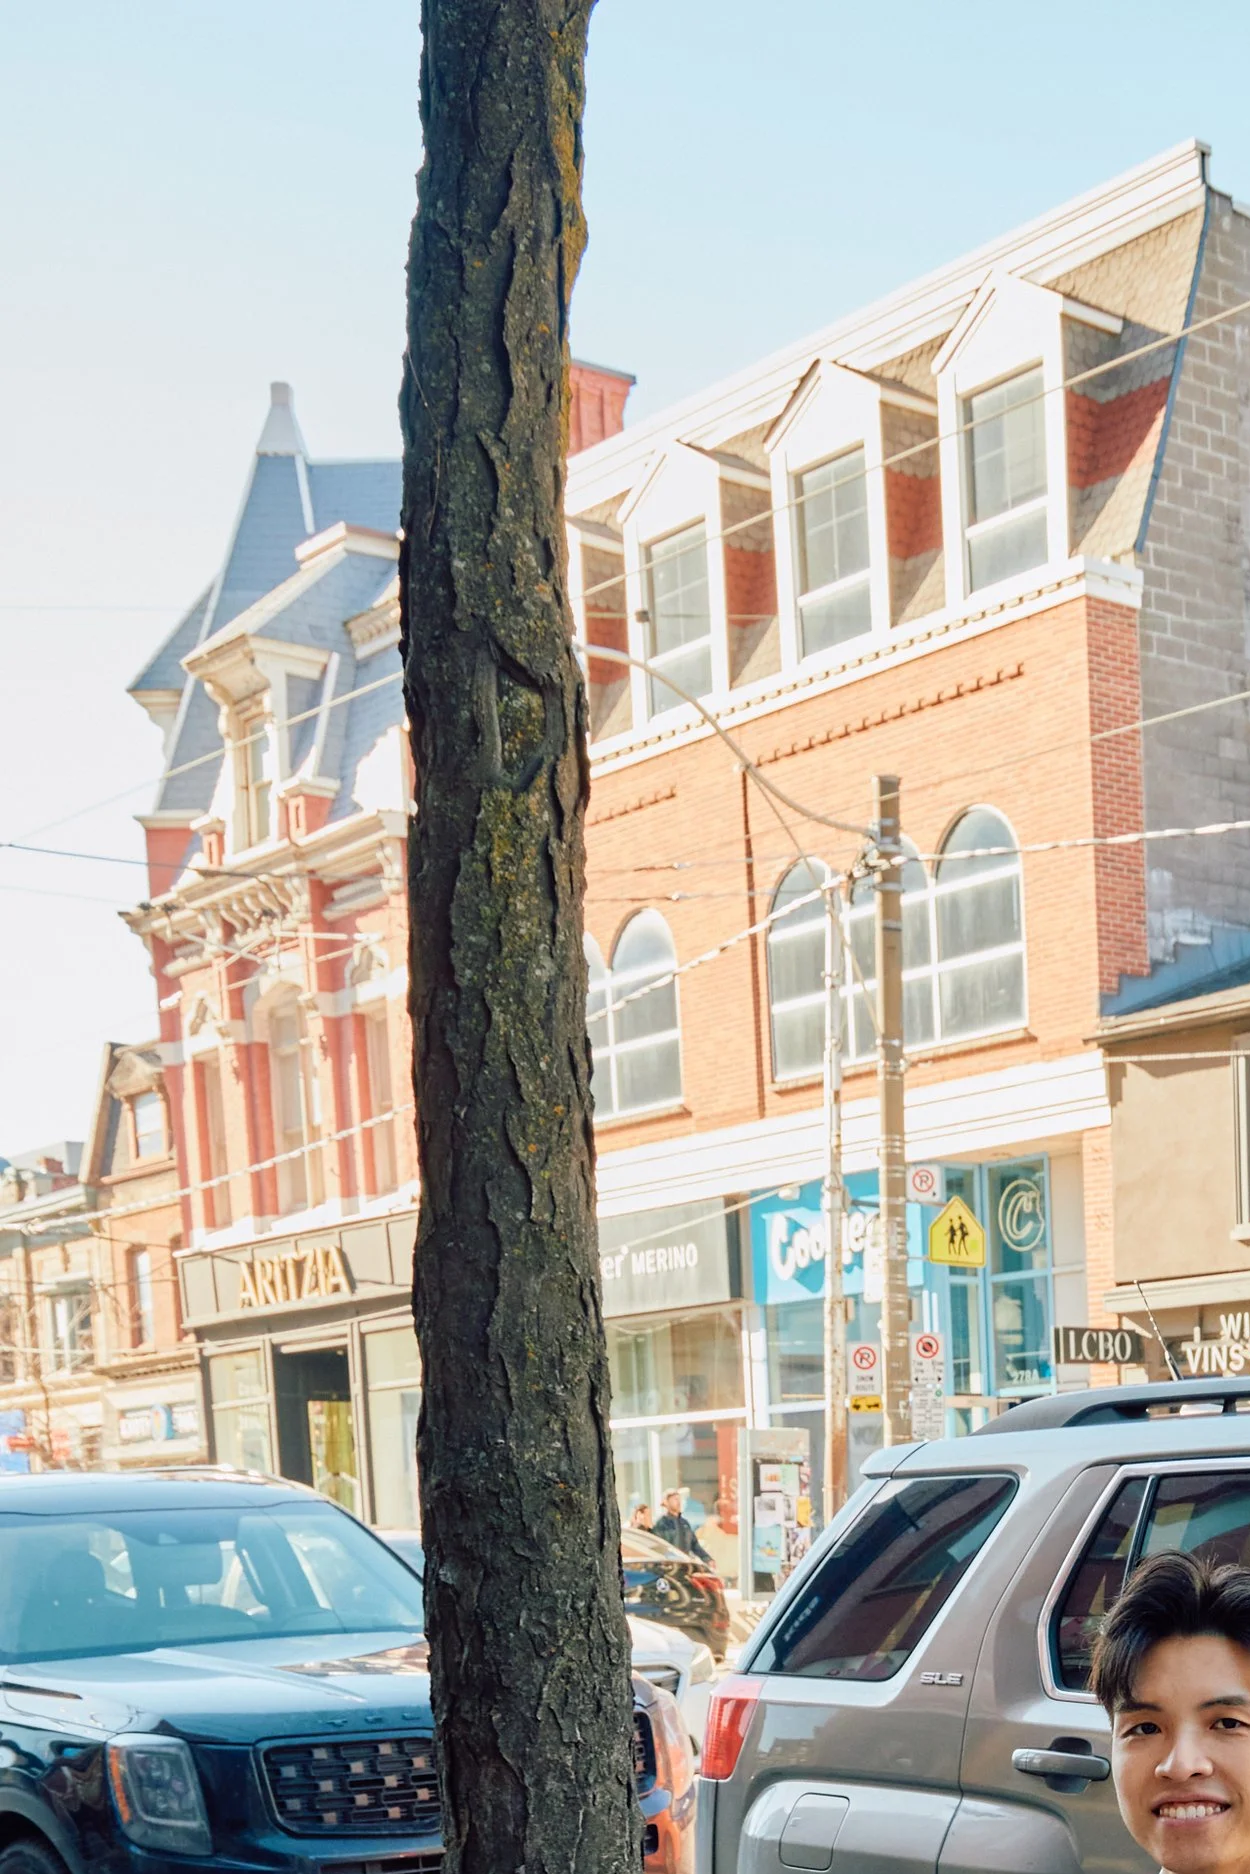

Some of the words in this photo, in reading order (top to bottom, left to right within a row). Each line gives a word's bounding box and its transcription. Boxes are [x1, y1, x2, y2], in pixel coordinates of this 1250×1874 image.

[631, 1242, 698, 1275] MERINO
[240, 1246, 350, 1308] ARITZIA
[1068, 1329, 1133, 1362] LCBO
[1011, 1368, 1041, 1385] 278A
[920, 1671, 963, 1686] SLE
